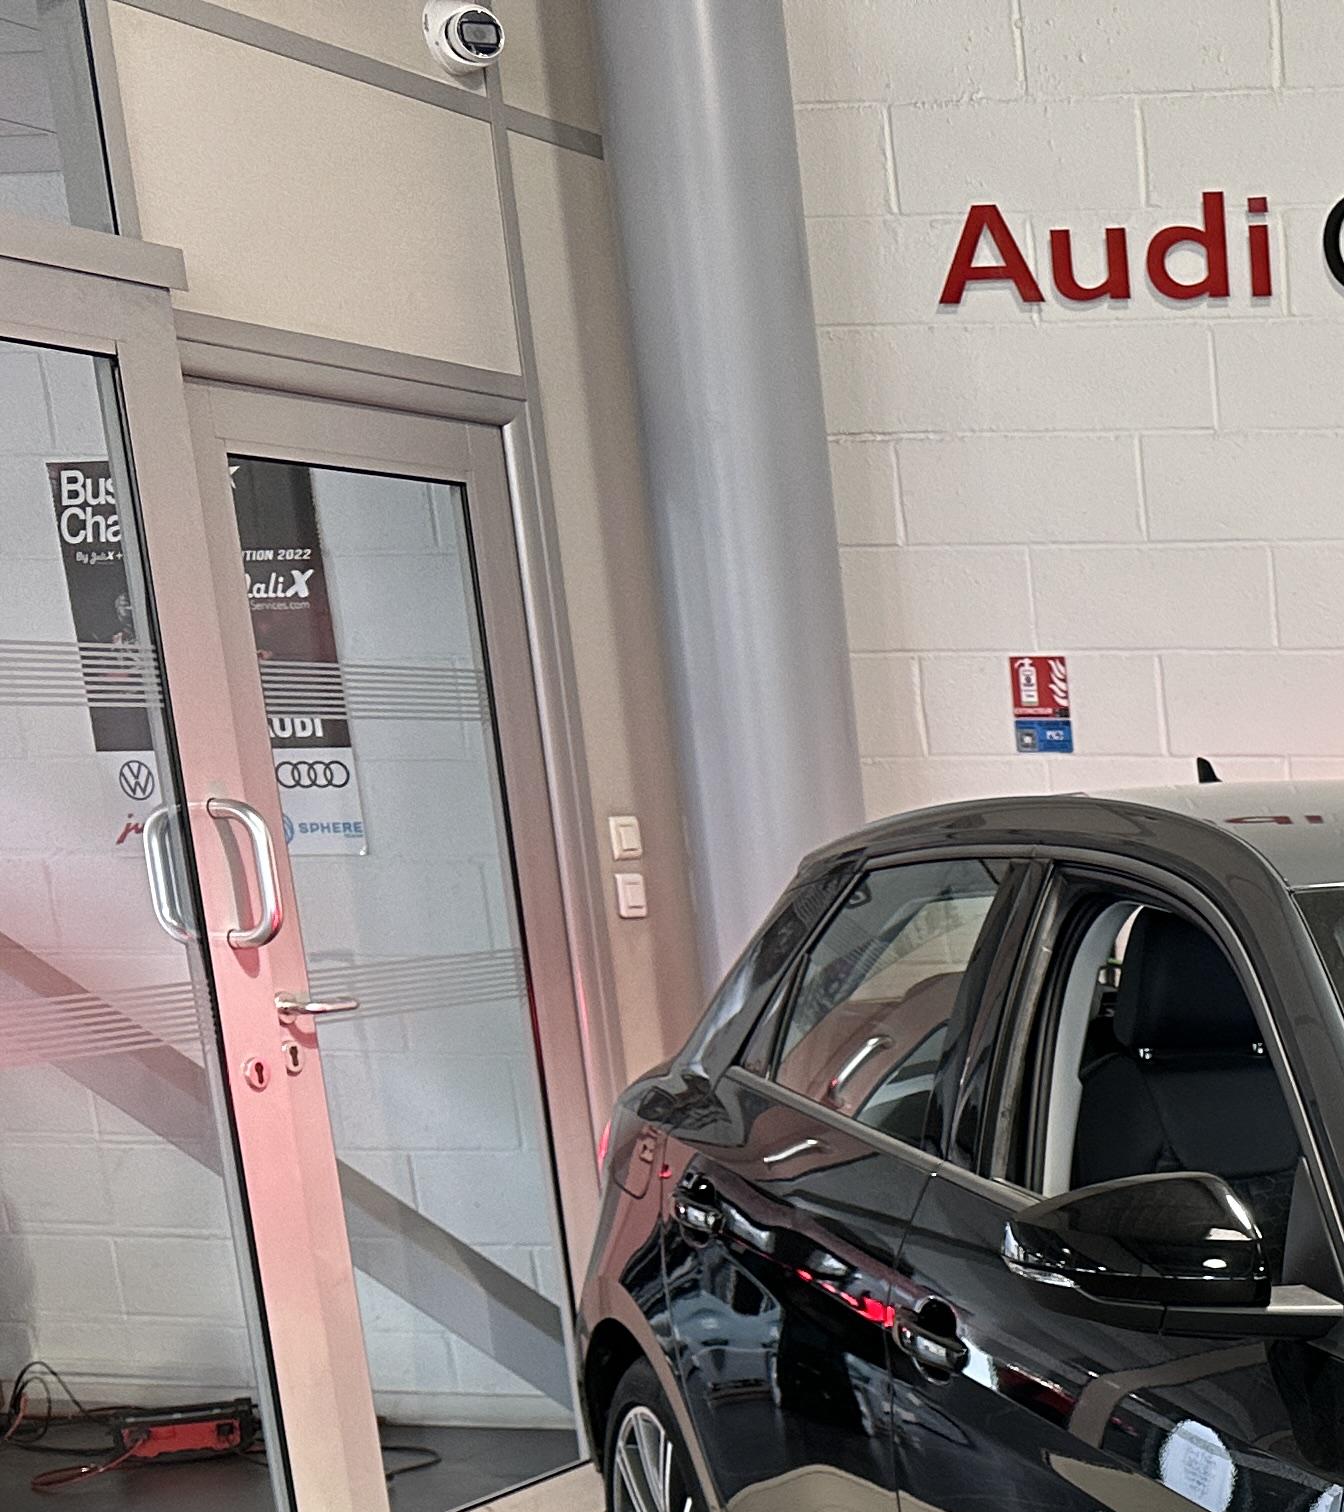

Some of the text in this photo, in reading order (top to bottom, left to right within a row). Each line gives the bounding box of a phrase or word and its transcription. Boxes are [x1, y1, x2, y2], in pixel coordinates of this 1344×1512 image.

[938, 190, 1276, 306] Audi
[277, 548, 312, 560] 2022
[298, 822, 363, 834] SPHERE
